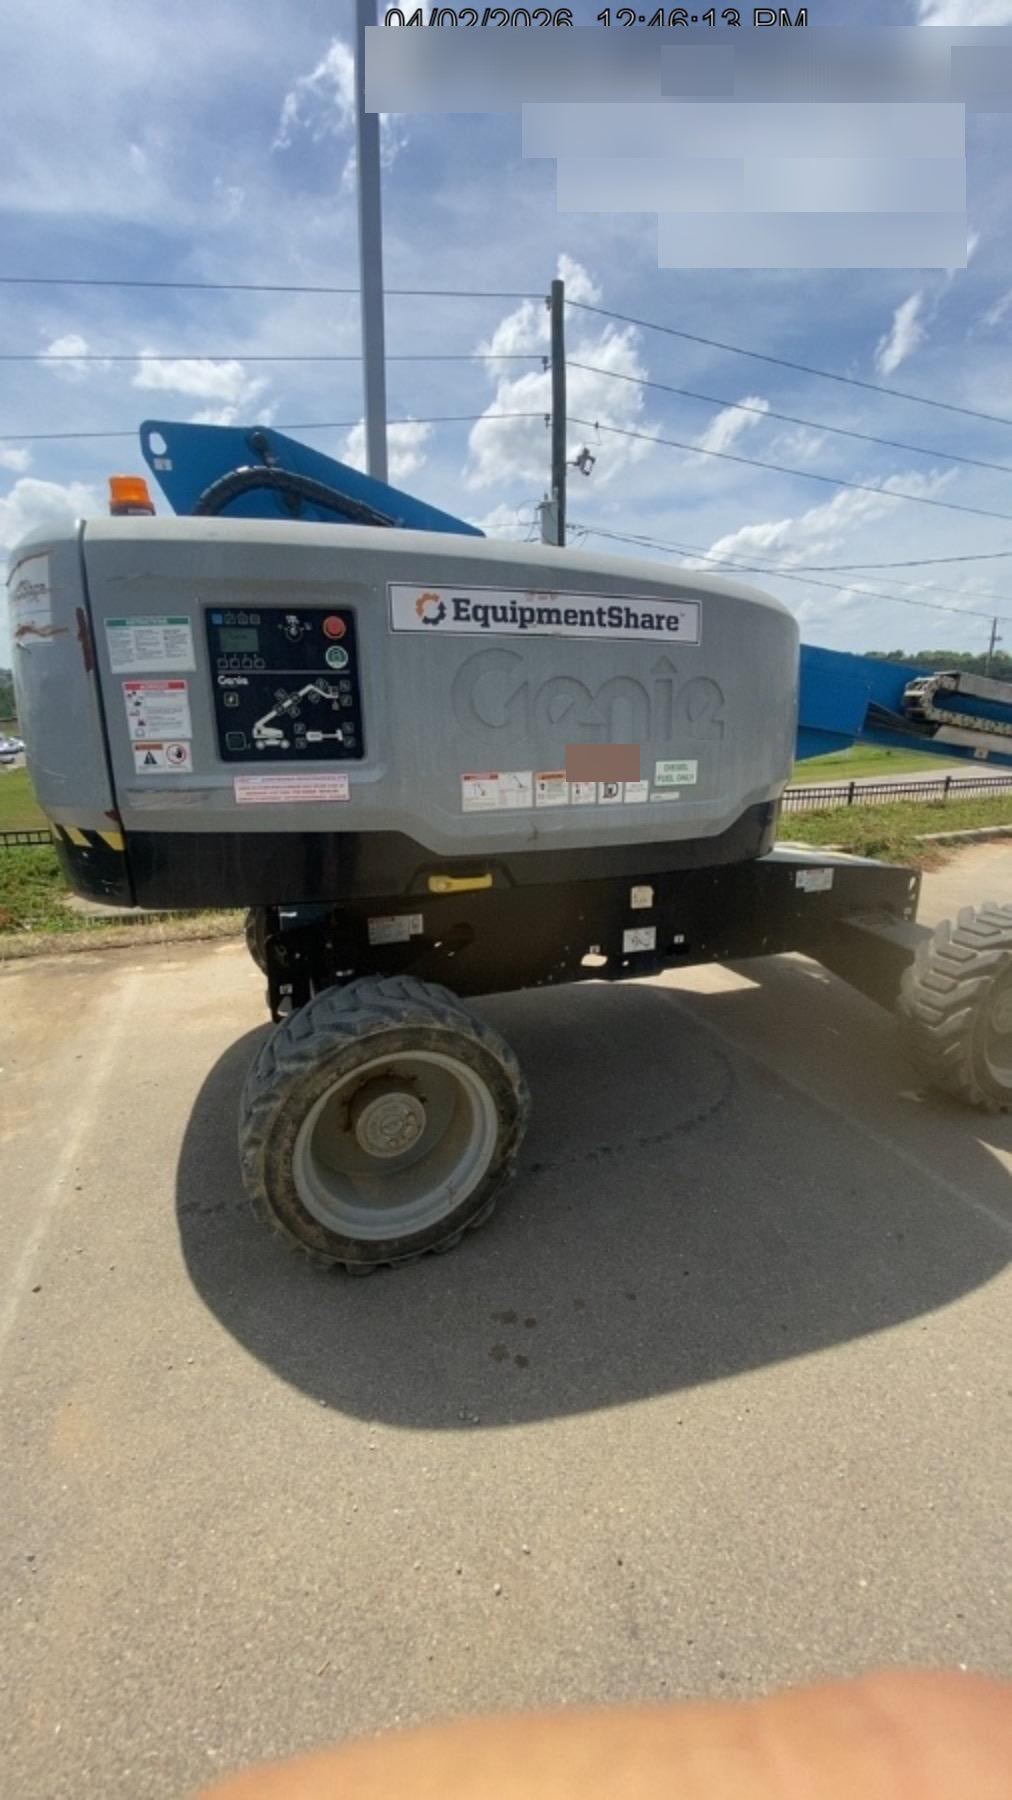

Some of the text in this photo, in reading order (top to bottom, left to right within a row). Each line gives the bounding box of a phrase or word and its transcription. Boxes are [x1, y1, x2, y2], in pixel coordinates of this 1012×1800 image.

[452, 597, 681, 632] EquipmentShare
[217, 675, 249, 686] Genie
[450, 647, 725, 744] Genie
